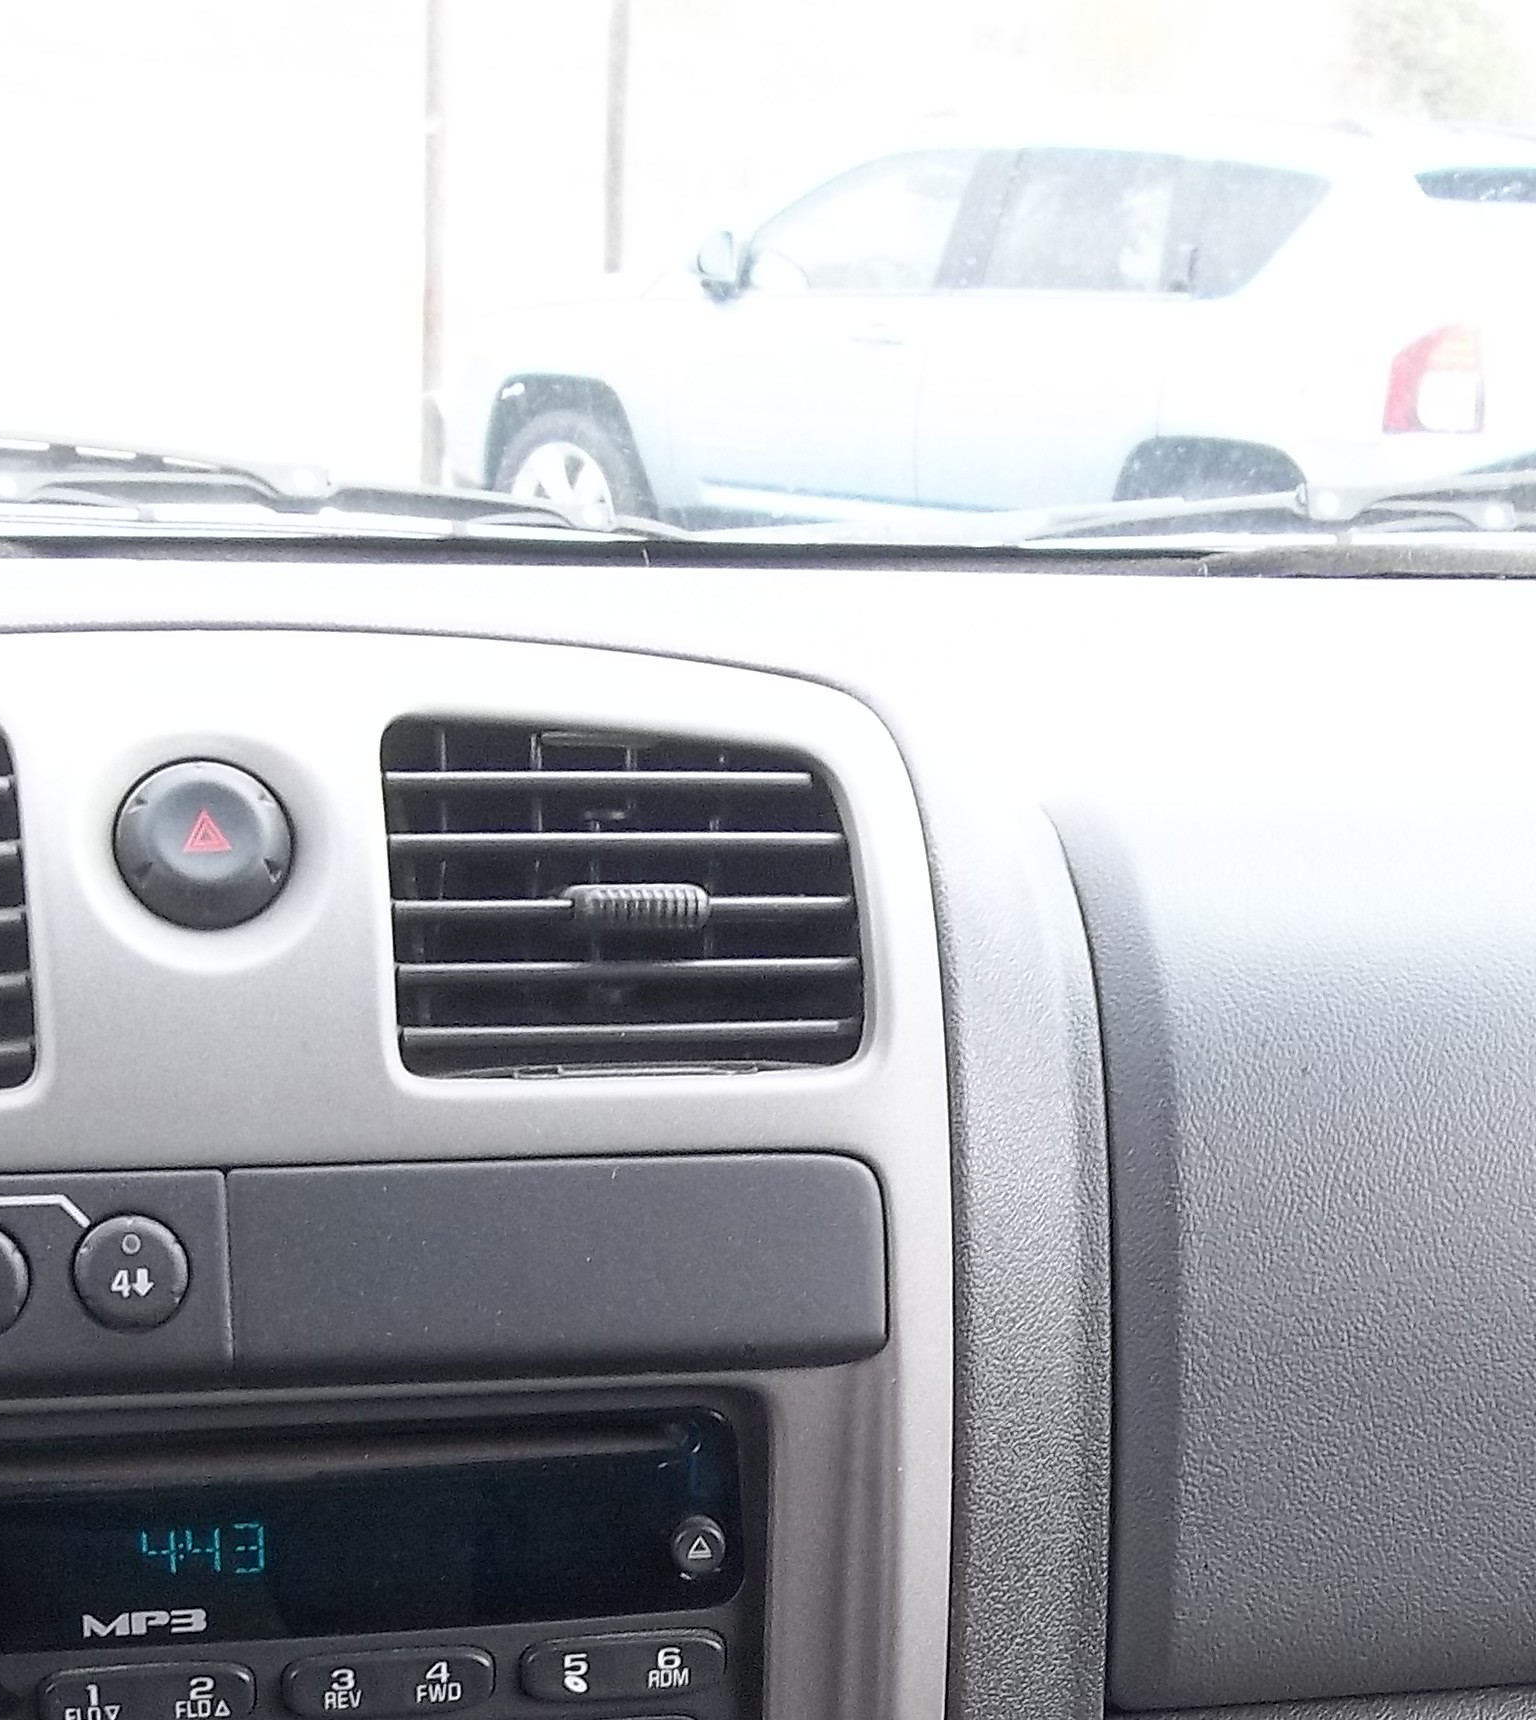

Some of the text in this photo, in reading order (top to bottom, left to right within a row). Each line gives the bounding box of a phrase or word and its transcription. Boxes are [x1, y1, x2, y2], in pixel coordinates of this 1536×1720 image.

[111, 1269, 131, 1298] 4
[82, 1608, 208, 1638] MP3
[564, 1653, 588, 1676] 5
[657, 1647, 681, 1669] 6
[330, 1668, 355, 1690] 3
[425, 1661, 451, 1683] 4
[648, 1667, 690, 1688] RDM
[86, 1684, 99, 1706] 1
[189, 1677, 214, 1700] 2
[324, 1689, 362, 1710] REV
[416, 1682, 462, 1703] FWD
[175, 1700, 211, 1719] FLD
